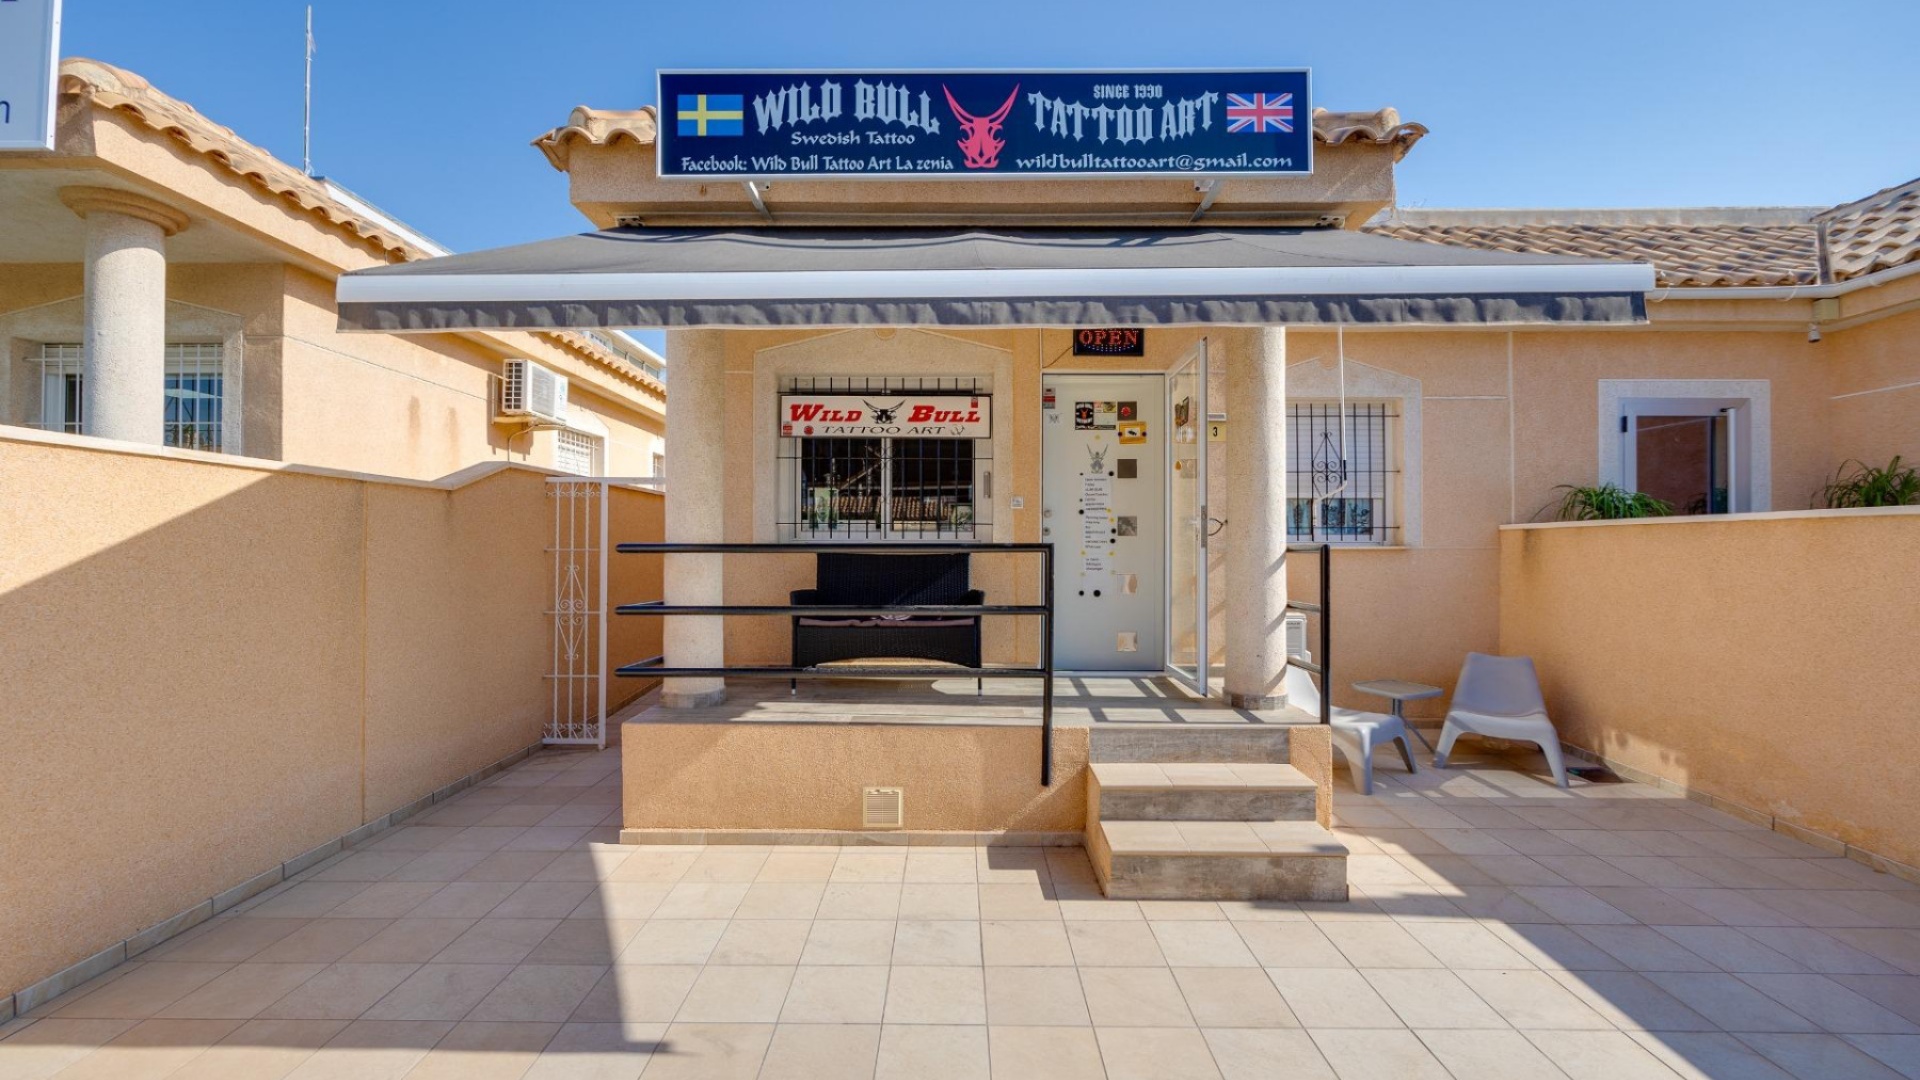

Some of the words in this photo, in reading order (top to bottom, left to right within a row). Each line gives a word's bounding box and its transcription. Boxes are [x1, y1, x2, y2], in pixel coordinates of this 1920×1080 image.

[1093, 84, 1130, 99] SINCE
[752, 78, 843, 136] WILD
[853, 78, 941, 136] BULL
[1027, 90, 1154, 146] TATTOO
[1159, 90, 1220, 142] ART
[790, 130, 861, 145] Swedish
[866, 131, 915, 145] Tattoo
[681, 155, 748, 172] Facebook:
[750, 155, 787, 171] Wild
[791, 155, 819, 171] Bull
[822, 156, 865, 171] Tattoo
[867, 156, 892, 171] Art
[895, 156, 914, 170] La
[916, 157, 953, 171] zenia
[1016, 152, 1293, 171] wildbulltattooart@gmail.com
[1078, 329, 1137, 346] OPEN
[789, 403, 863, 423] WILD
[906, 404, 981, 424] BULL
[821, 425, 901, 435] TATTOO
[907, 425, 946, 435] ART
[1212, 426, 1219, 437] 3
